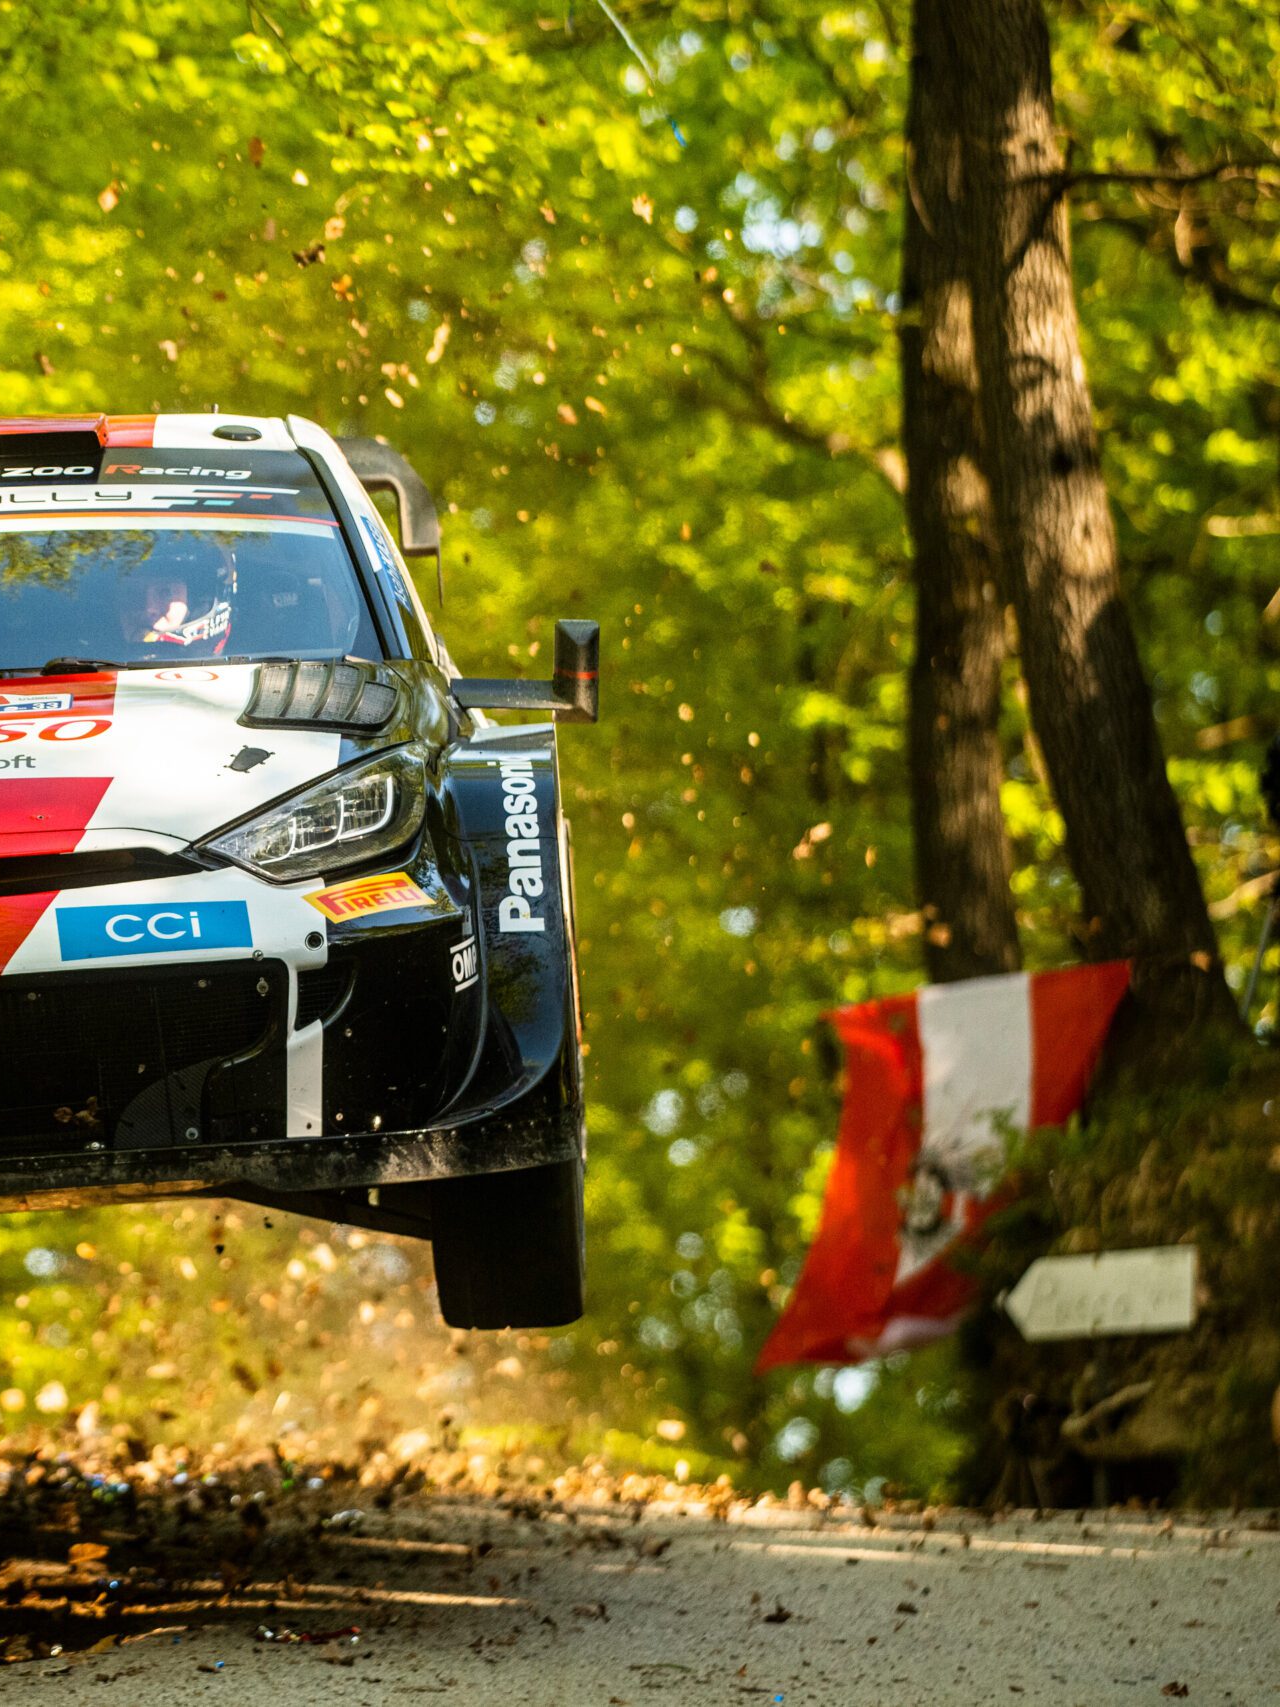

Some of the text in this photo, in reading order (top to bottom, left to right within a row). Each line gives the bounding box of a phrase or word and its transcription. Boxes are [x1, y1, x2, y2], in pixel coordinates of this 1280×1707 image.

[104, 464, 252, 480] Racing
[487, 756, 546, 933] Panasoni
[315, 878, 422, 916] PIRELLI
[452, 943, 478, 983] OMP
